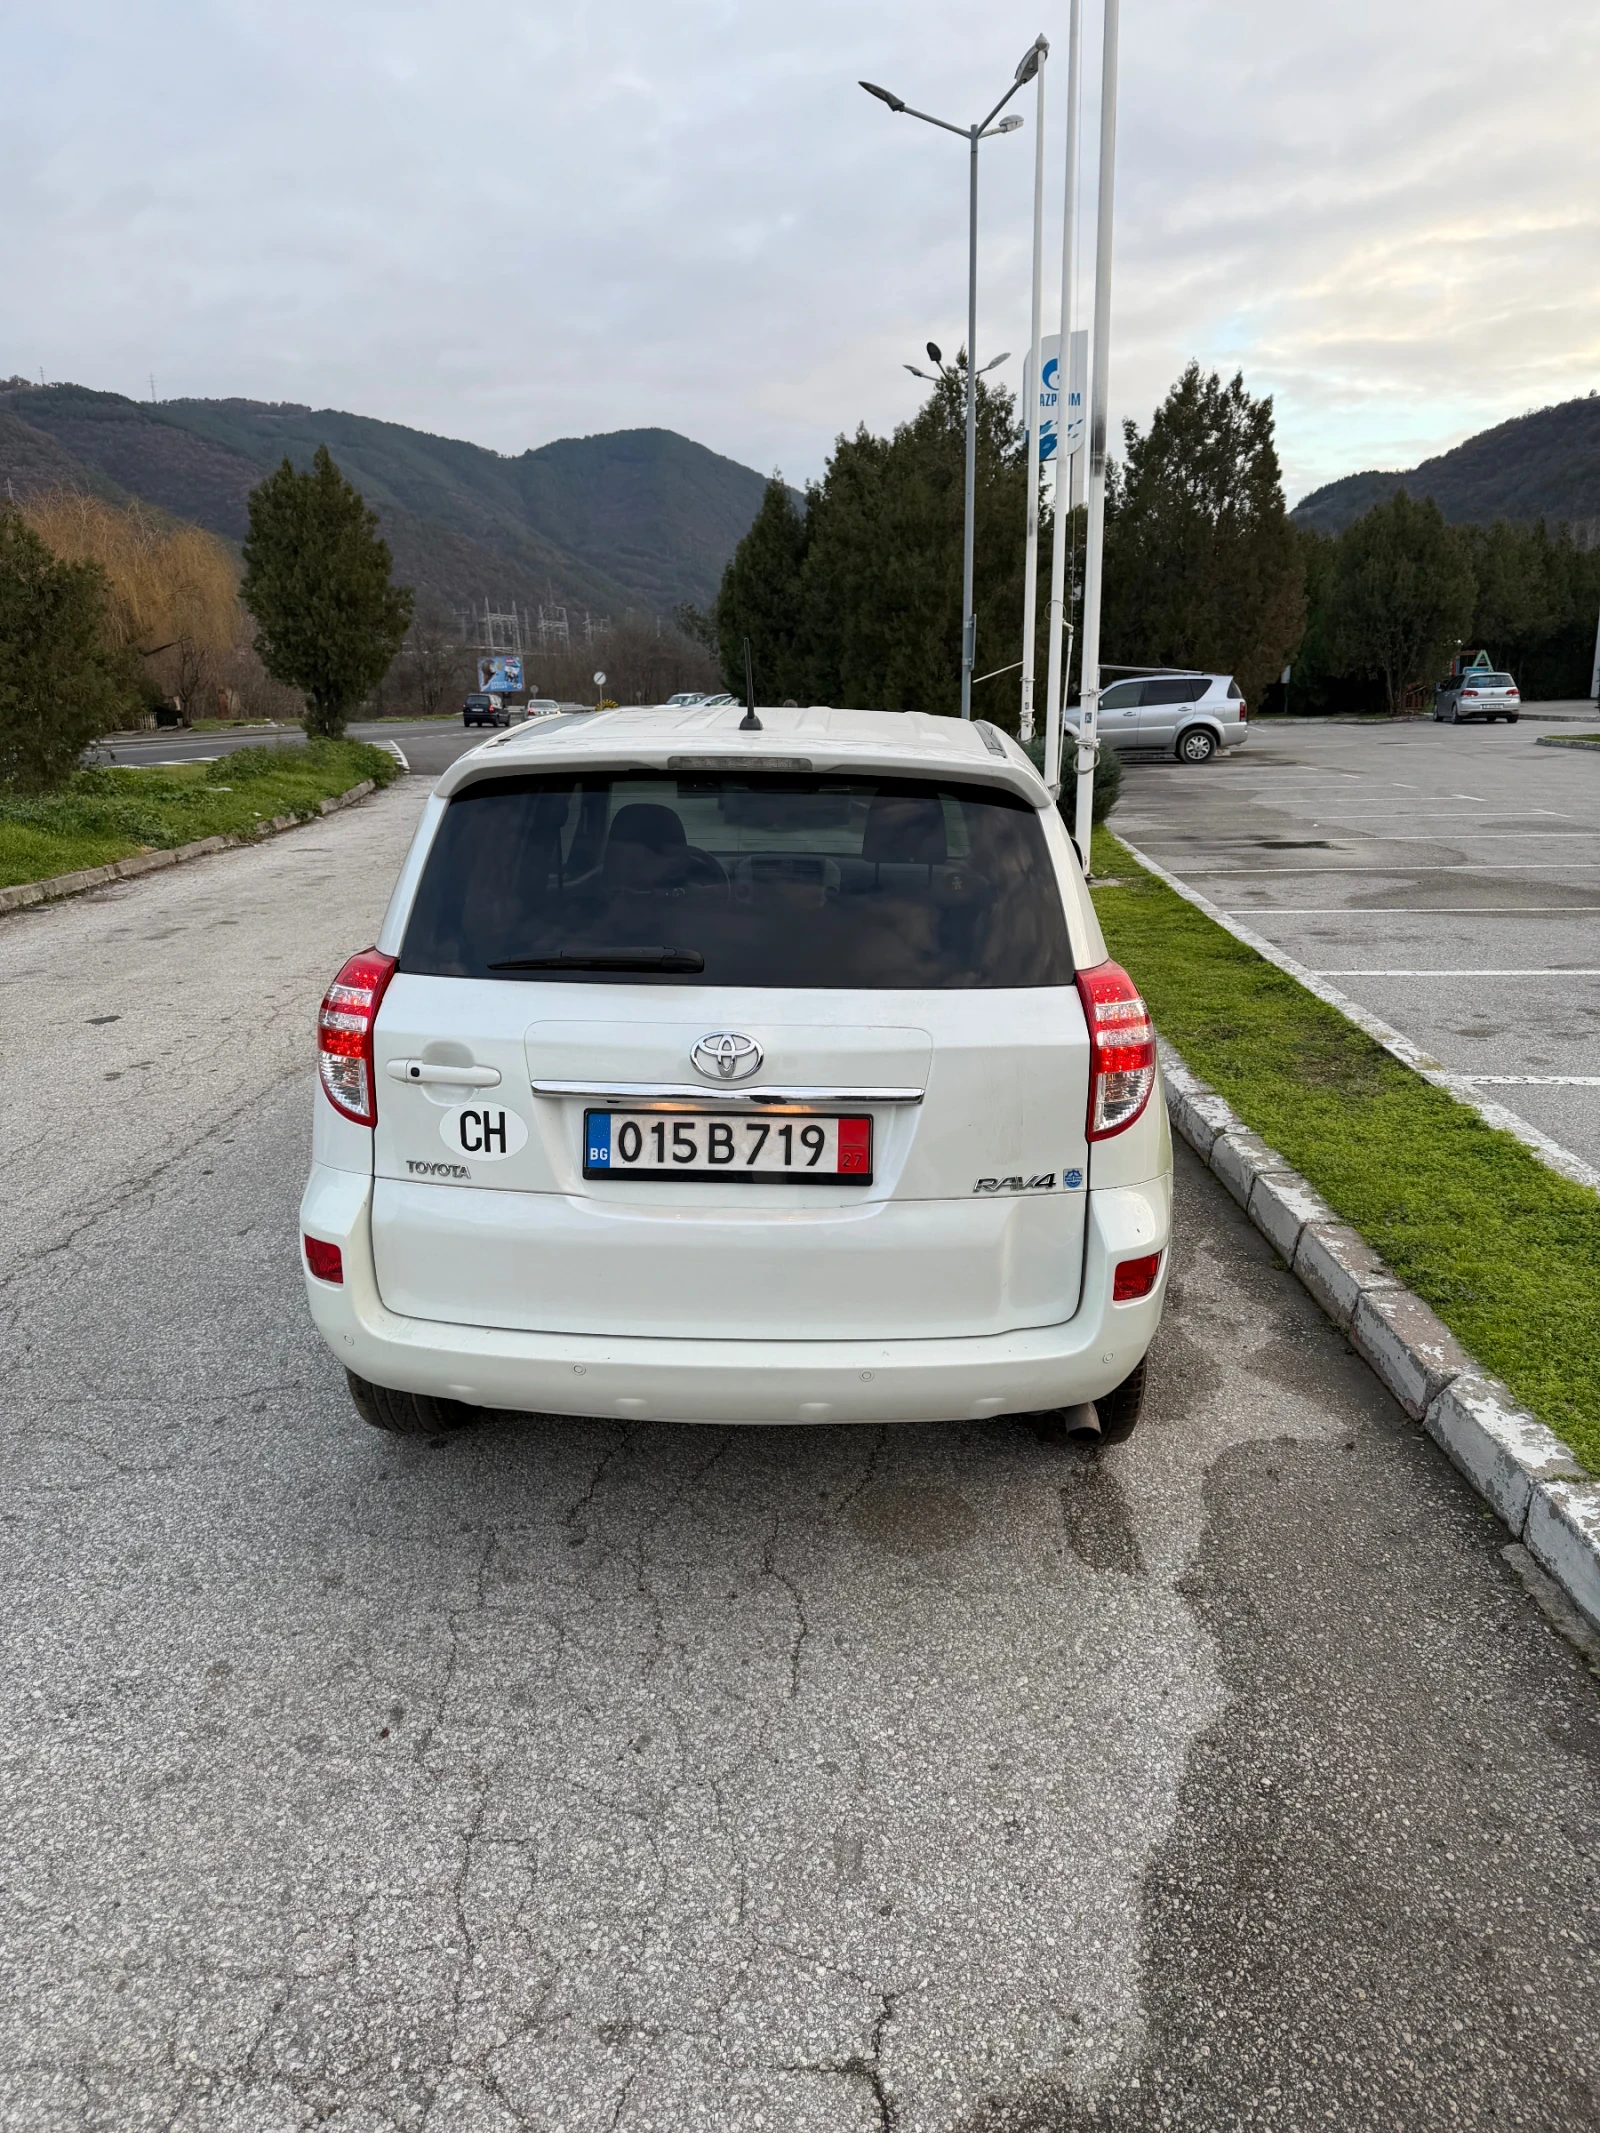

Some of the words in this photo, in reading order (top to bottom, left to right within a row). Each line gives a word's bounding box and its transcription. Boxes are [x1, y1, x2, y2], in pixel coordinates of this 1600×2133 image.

[1039, 392, 1081, 406] AZPM
[459, 1110, 507, 1153] CH
[590, 1148, 608, 1161] BG
[842, 1153, 863, 1168] 27
[406, 1160, 472, 1179] TOYOTA
[972, 1172, 1057, 1193] RAV4
